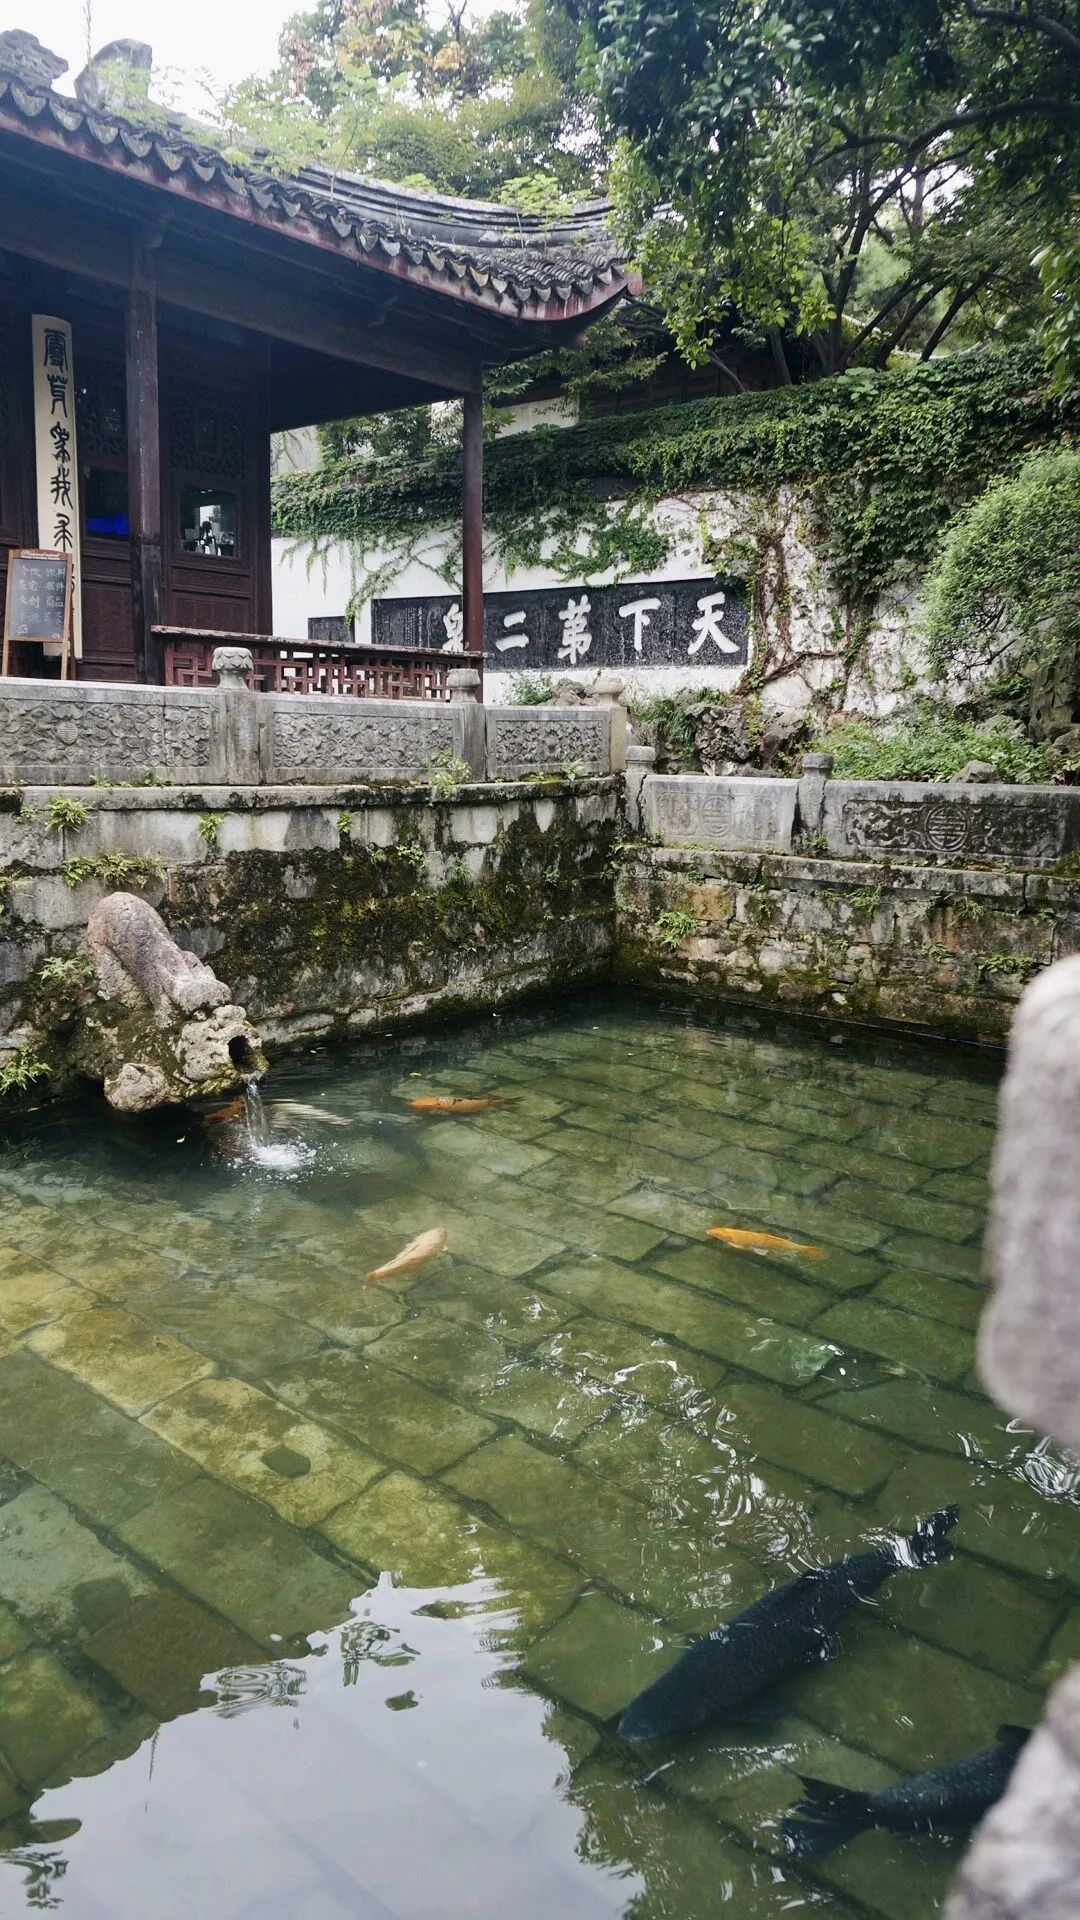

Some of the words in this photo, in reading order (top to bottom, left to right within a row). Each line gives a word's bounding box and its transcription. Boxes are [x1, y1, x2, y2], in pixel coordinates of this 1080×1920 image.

[442, 591, 740, 664] 天下第二泉
